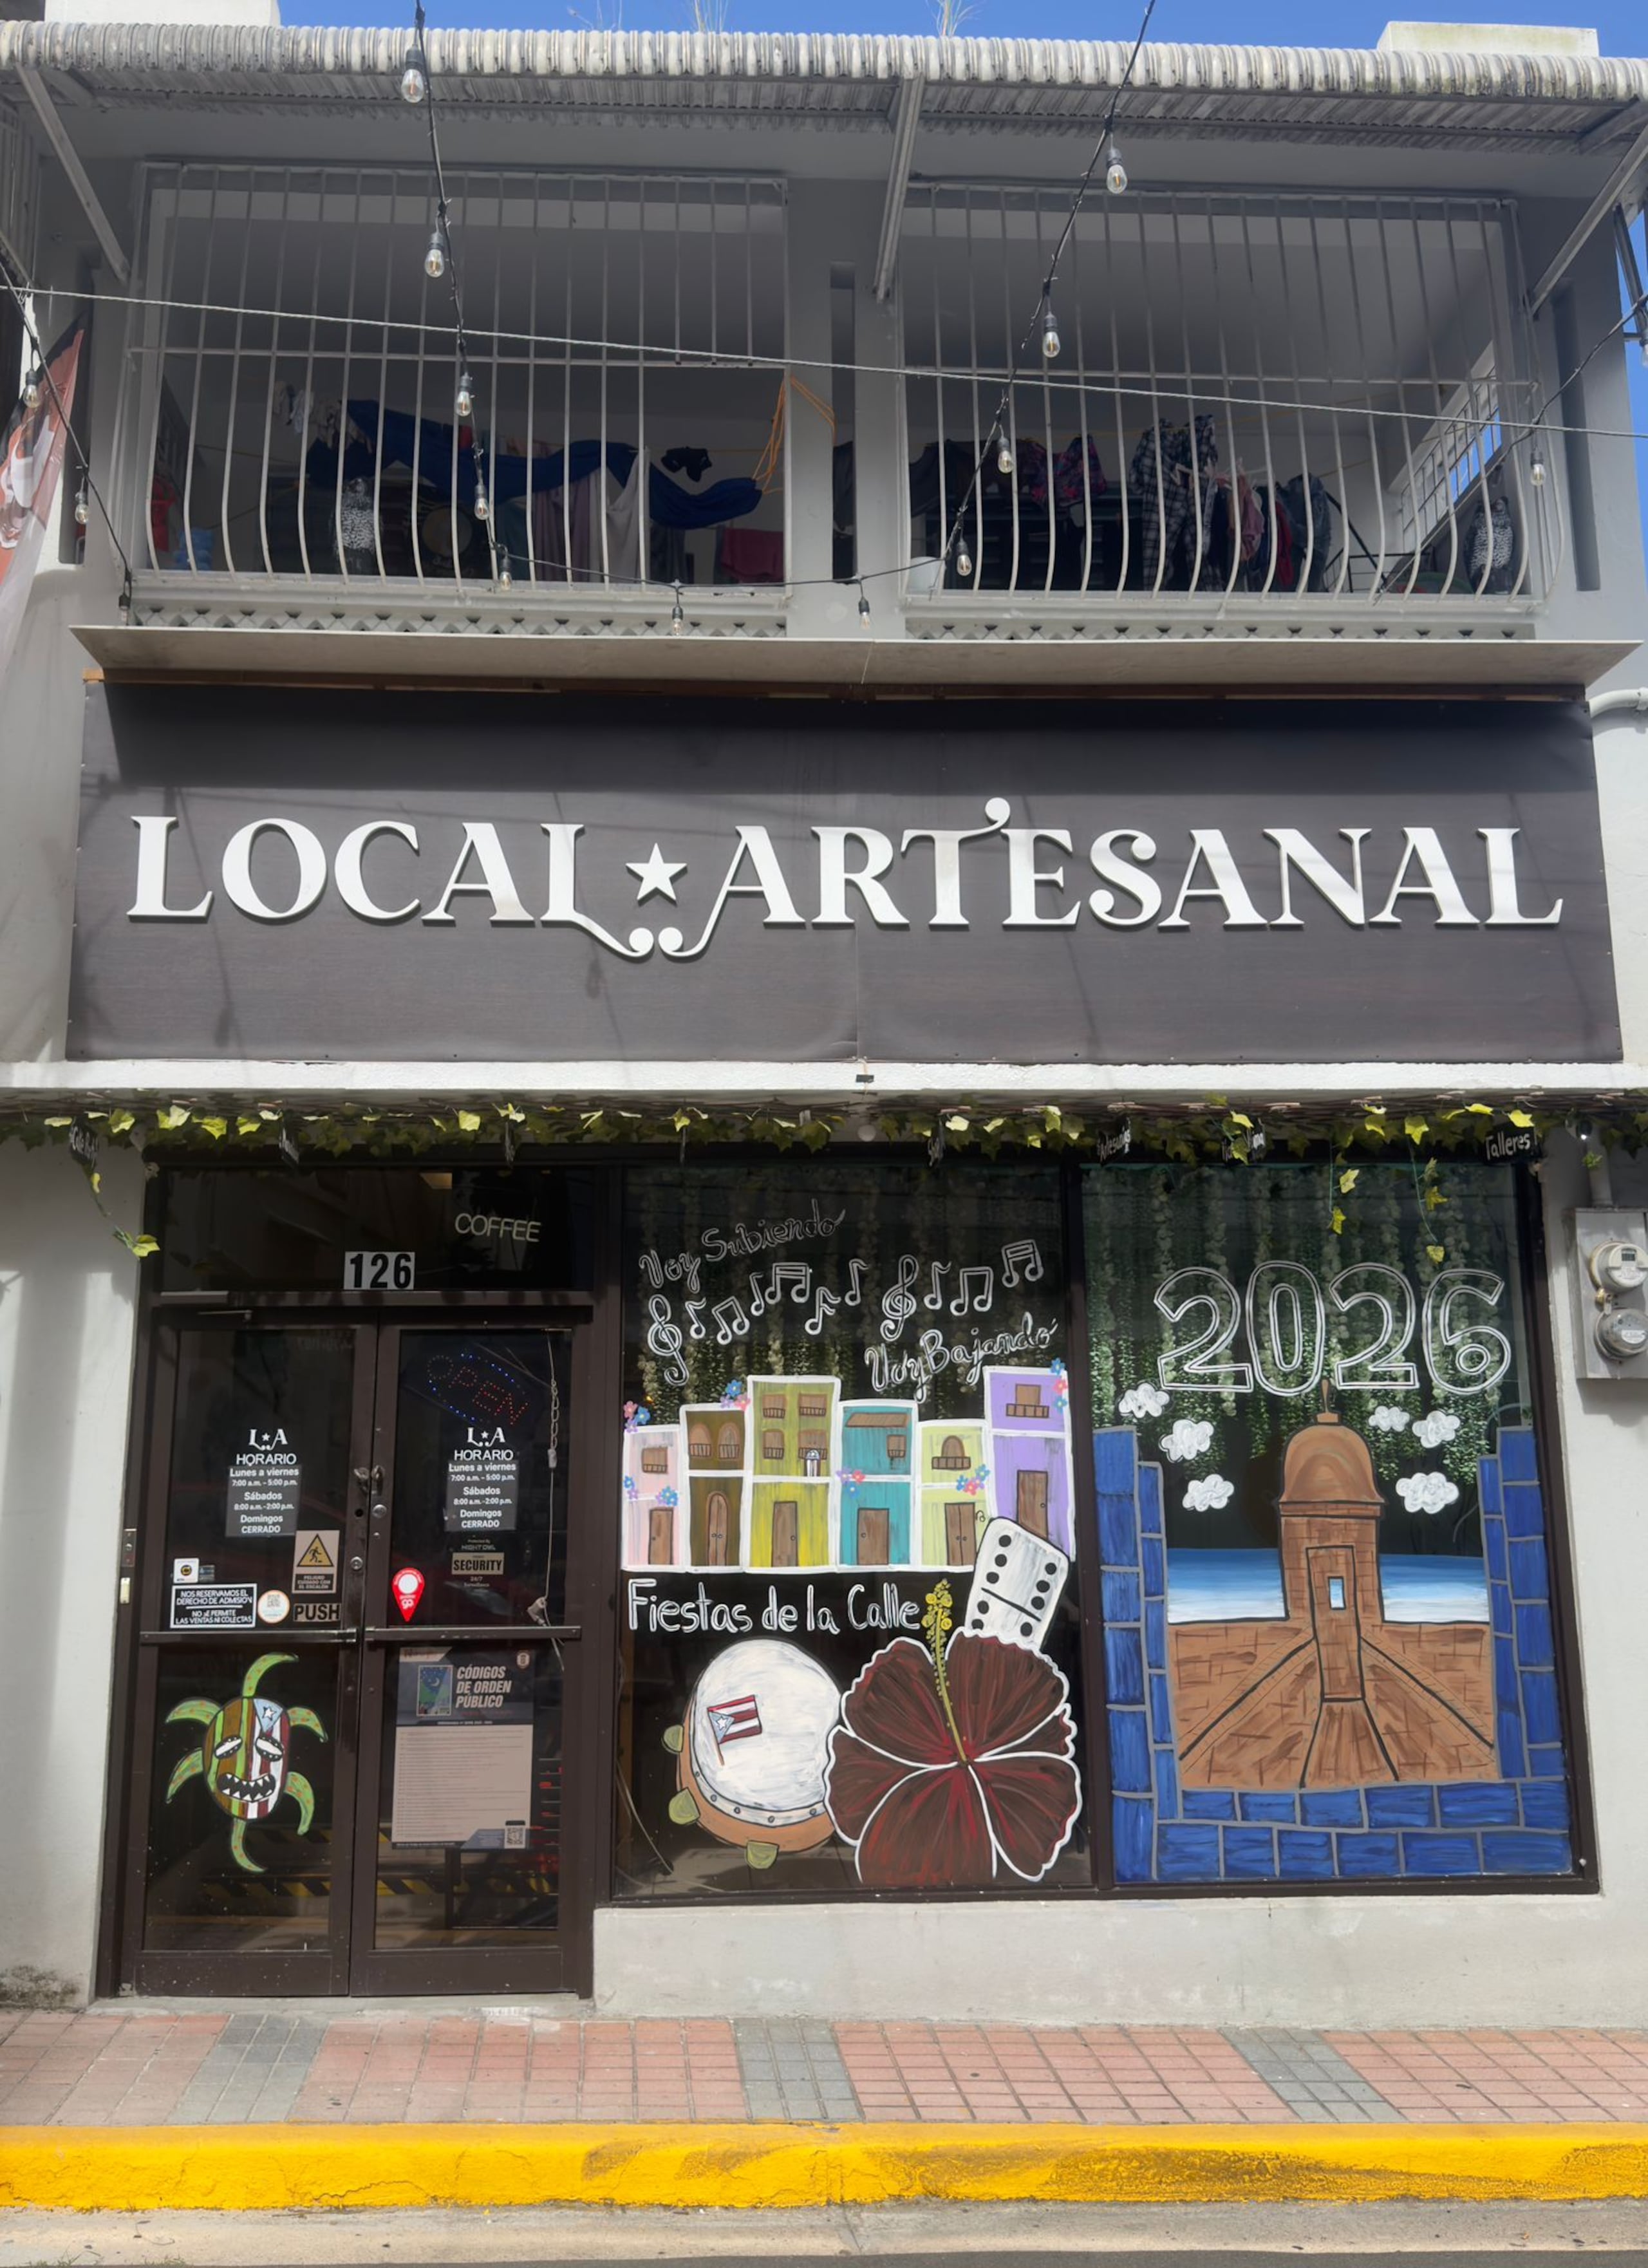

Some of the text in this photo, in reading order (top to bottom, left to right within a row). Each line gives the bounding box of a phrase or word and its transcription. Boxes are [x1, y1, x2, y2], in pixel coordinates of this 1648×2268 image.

[126, 796, 1563, 960] LOCAL ARTESANAL
[1486, 1131, 1531, 1161] Talleres
[454, 1213, 541, 1242] COFFEE
[639, 1198, 846, 1294] Voy Subiendo
[350, 1253, 412, 1289] 126
[1154, 1261, 1512, 1396] 2026
[864, 1311, 1058, 1404] Voy Bajando
[427, 1354, 528, 1425] OPEN
[236, 1453, 297, 1465] HORARIO
[454, 1450, 514, 1461] HORARIO
[230, 1468, 257, 1477] Lunes
[267, 1467, 299, 1476] viernes
[449, 1463, 474, 1472] Lunes
[485, 1463, 516, 1471] viernes
[244, 1492, 283, 1501] Sábados
[463, 1486, 501, 1495] Sábados
[240, 1515, 283, 1524] Domingos
[460, 1509, 502, 1519] Domingos
[462, 1520, 500, 1528] CERRADO
[453, 1560, 501, 1571] SECURITY
[294, 1604, 339, 1620] PUSH
[627, 1579, 921, 1635] Fiestas de la Calle
[456, 1664, 506, 1679] CÓDIGOS
[456, 1680, 512, 1694] DE ORDEN
[456, 1693, 503, 1708] PÚBLICO
